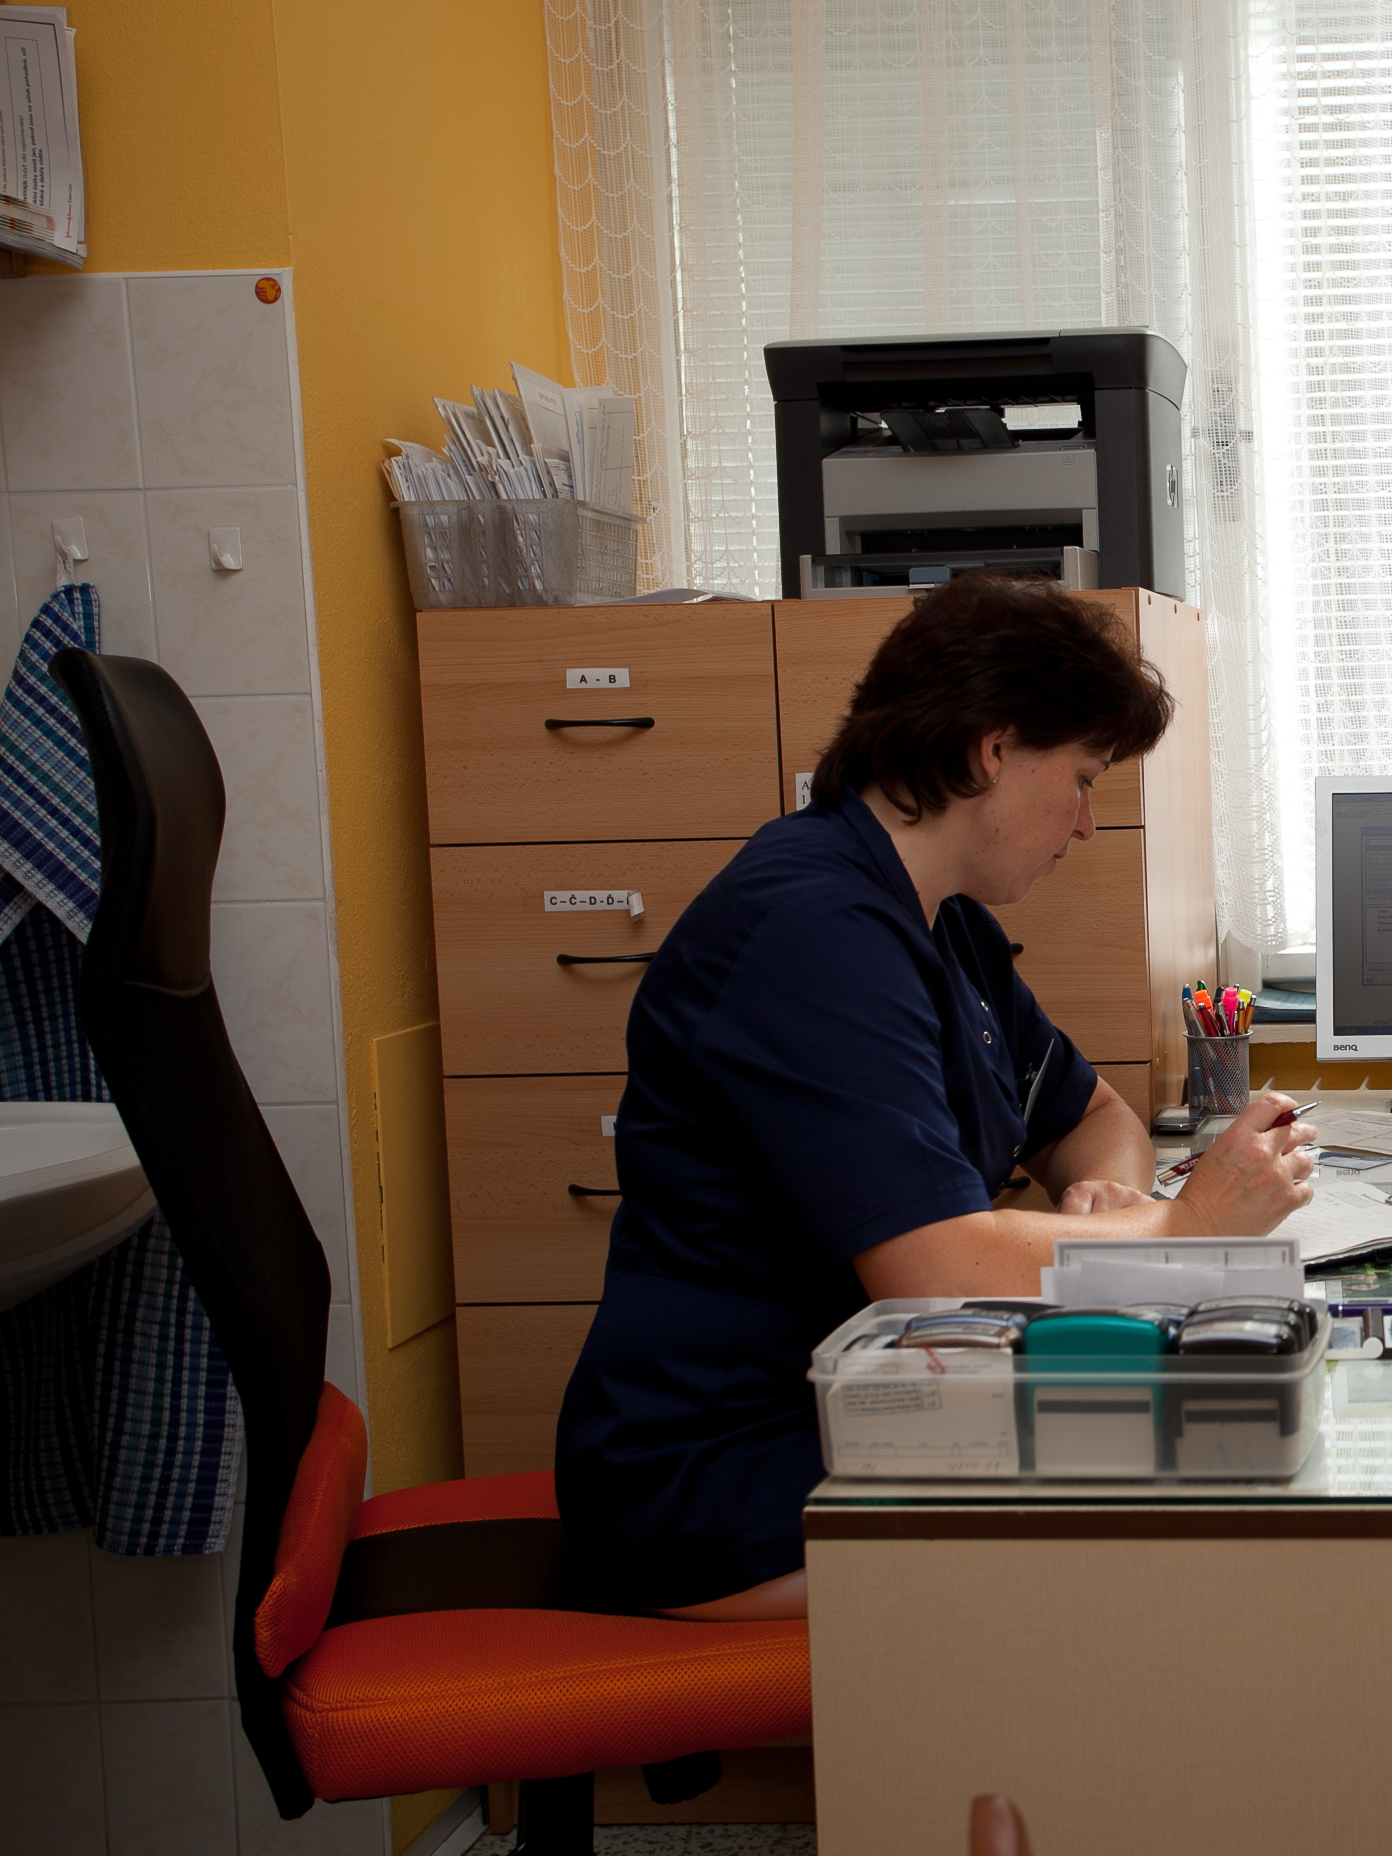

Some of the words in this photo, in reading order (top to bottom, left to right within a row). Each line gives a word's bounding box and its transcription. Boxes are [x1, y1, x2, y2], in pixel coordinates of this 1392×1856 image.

[28, 104, 32, 112] na
[28, 114, 36, 126] jsou
[579, 674, 588, 684] A
[608, 674, 617, 684] B
[801, 780, 810, 790] A
[1333, 1044, 1358, 1052] BenQ
